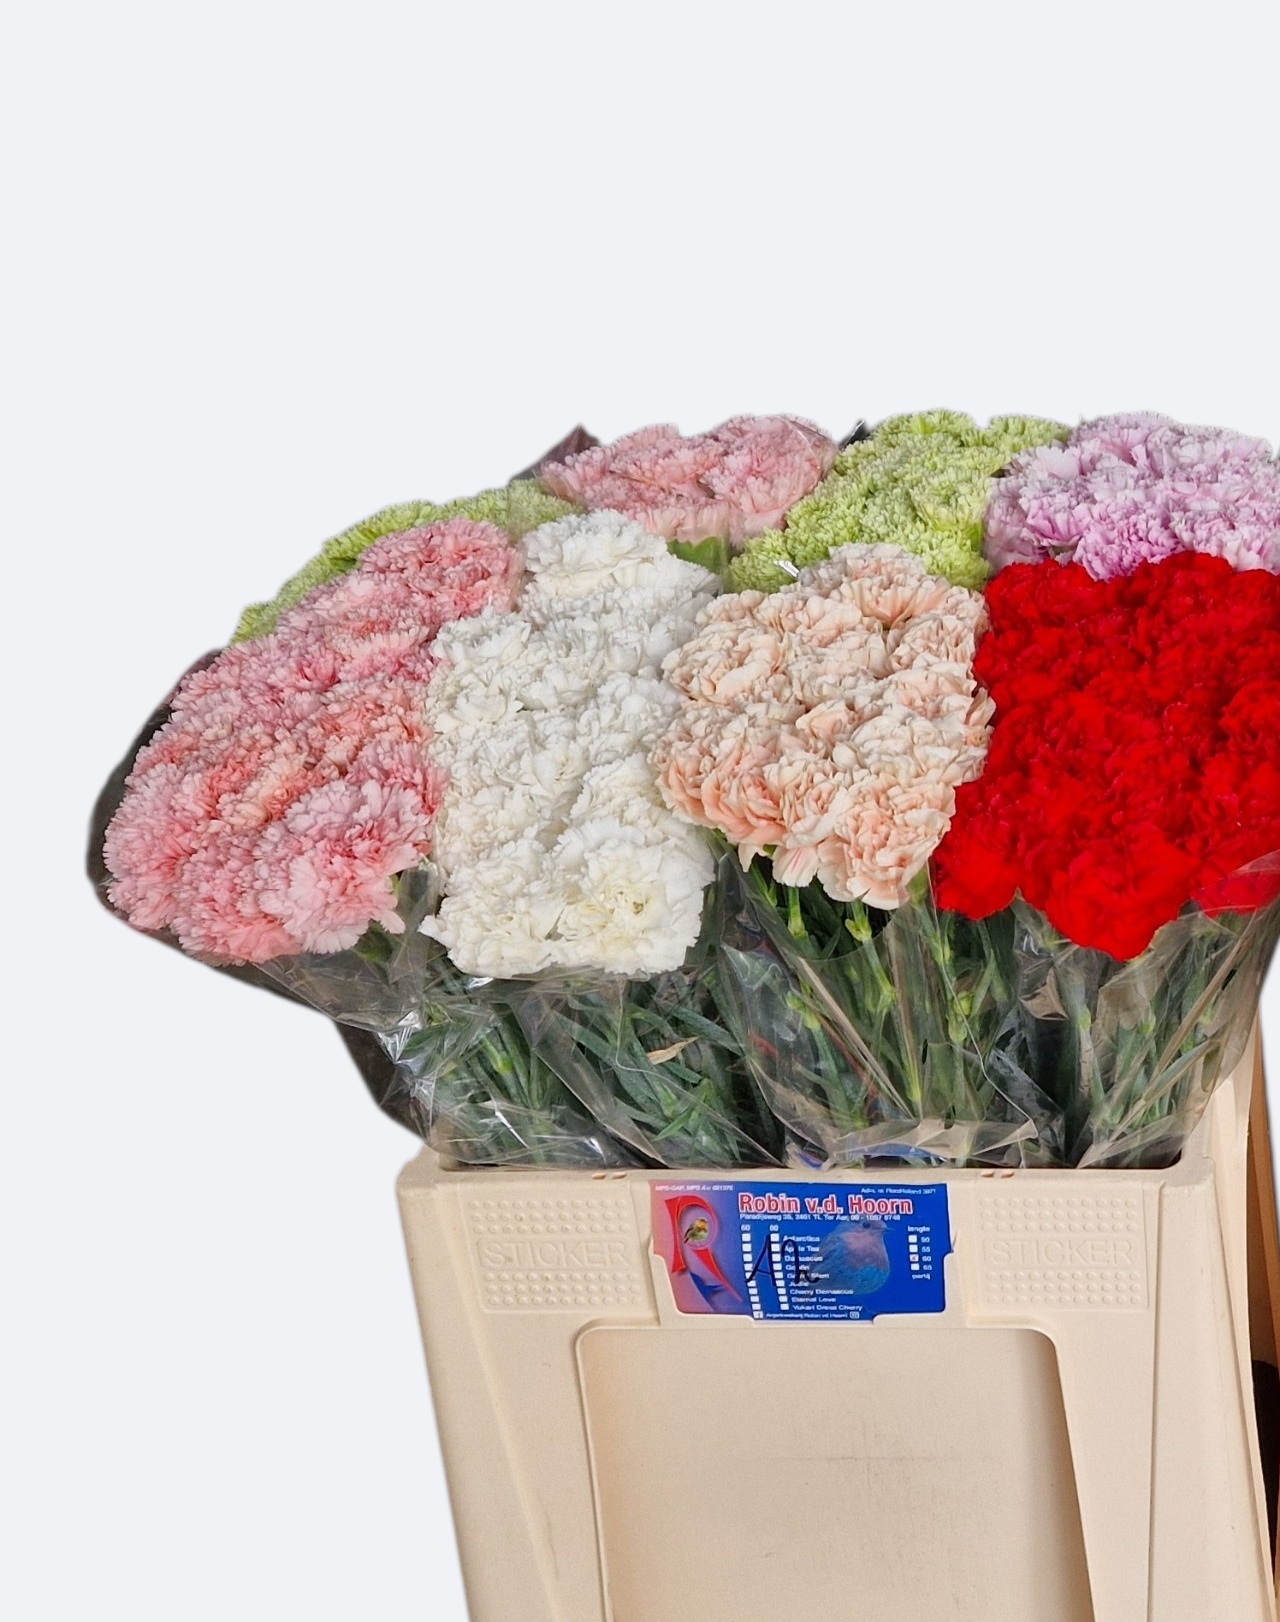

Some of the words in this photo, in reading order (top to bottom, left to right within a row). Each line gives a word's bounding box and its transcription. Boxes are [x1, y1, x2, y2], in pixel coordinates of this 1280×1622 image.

[738, 1192, 800, 1213] Robin
[804, 1194, 844, 1214] v.d.
[848, 1194, 913, 1214] Hoorn
[482, 1241, 630, 1269] STICKER
[993, 1239, 1134, 1266] STICKER
